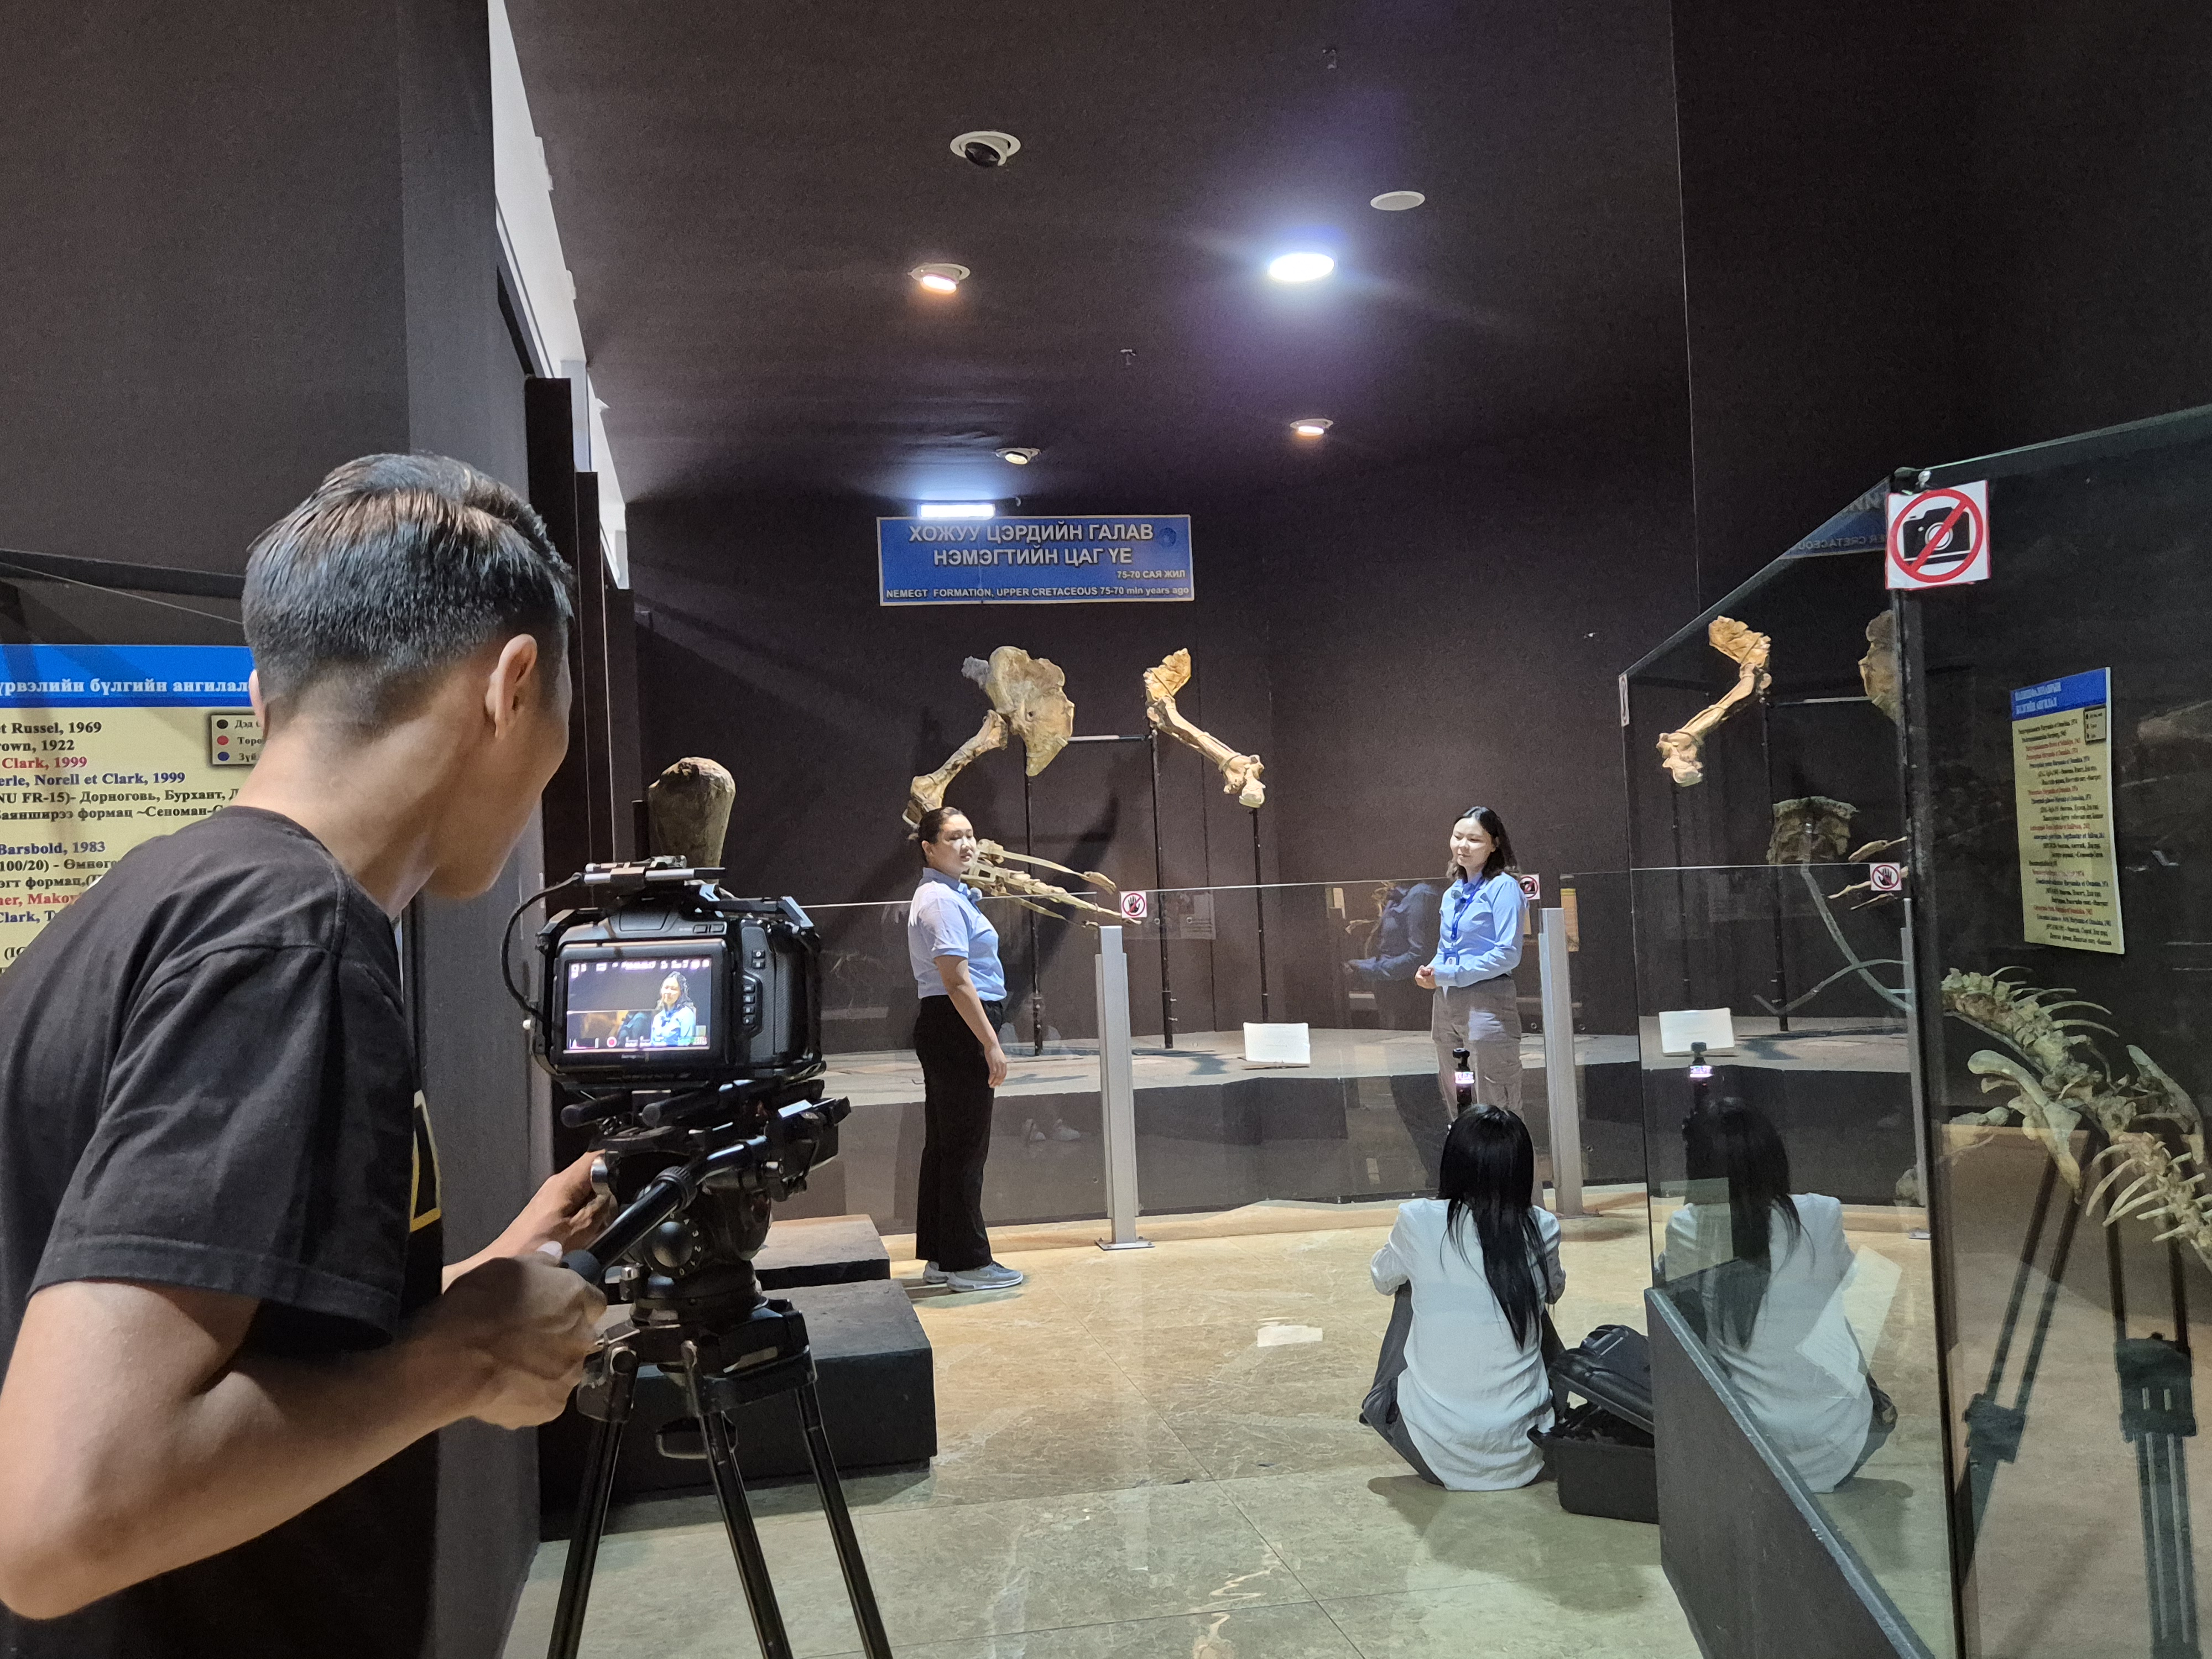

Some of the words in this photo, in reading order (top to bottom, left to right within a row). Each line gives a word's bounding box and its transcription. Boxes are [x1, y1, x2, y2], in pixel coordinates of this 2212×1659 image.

[909, 525, 980, 542] ХОЖУУ
[987, 520, 1082, 544] ЦЭРДИЙН
[1089, 524, 1154, 540] ГАЛАВ
[934, 544, 1058, 566] НЭМЭГТИЙН
[1065, 548, 1103, 567] ЦАГ
[1117, 570, 1141, 578] 75-70
[1142, 570, 1162, 578] САЯ
[1164, 570, 1186, 578] ЖИЛ
[886, 589, 928, 598] NEMEGT
[933, 588, 994, 598] FORMATION,
[997, 587, 1030, 597] UPPER
[1031, 587, 1098, 596] CRETACEOUS
[1100, 586, 1124, 595] 75-70
[1145, 587, 1170, 596] years
[1172, 587, 1190, 596] ago
[90, 678, 168, 696] бүлгийн
[0, 723, 7, 734] t
[11, 722, 64, 735] Russel,
[69, 721, 102, 734] 1969
[0, 742, 36, 753] own,
[41, 739, 75, 751] 1922
[2, 757, 49, 770] Clark,
[54, 756, 87, 768] 1999
[238, 753, 258, 763] Зүй
[34, 774, 80, 786] Norell
[84, 774, 98, 785] et
[102, 773, 148, 786] Clark,
[153, 772, 185, 784] 1999
[22, 791, 77, 805] FR-15)-
[79, 791, 160, 805] Дорноговь,
[164, 789, 226, 803] Бурхант,
[0, 810, 74, 822] аянширээ
[78, 807, 133, 822] формац
[0, 842, 68, 855] Barsbold,
[72, 841, 106, 853] 1983
